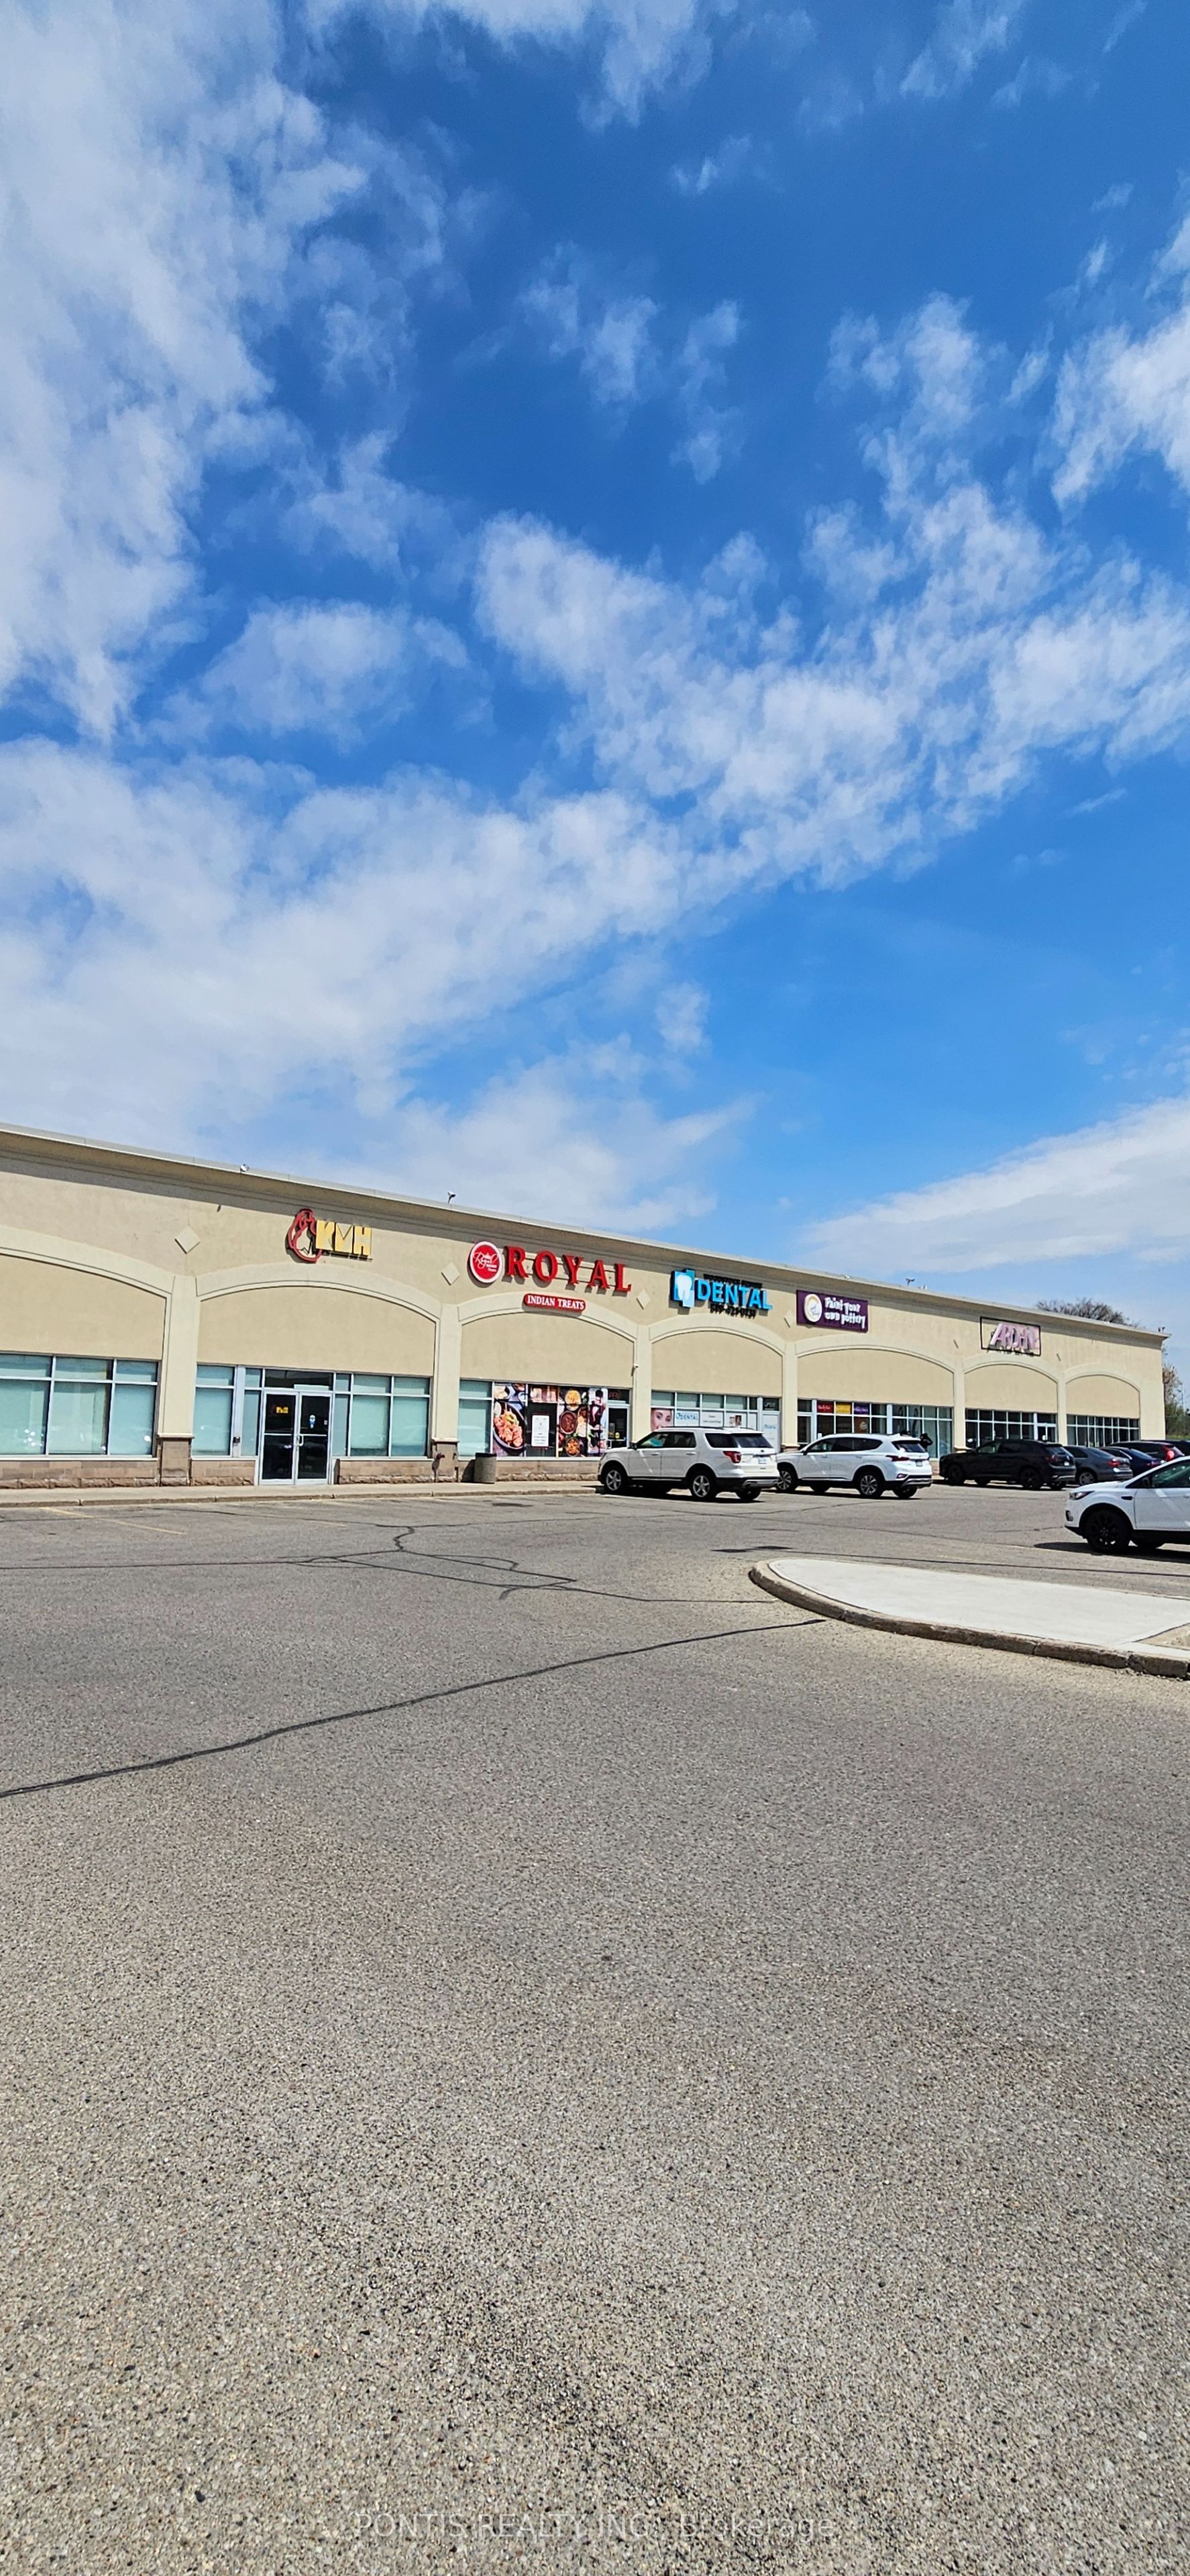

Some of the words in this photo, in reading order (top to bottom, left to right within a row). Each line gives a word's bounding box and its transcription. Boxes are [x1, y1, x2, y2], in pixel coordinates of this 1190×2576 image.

[504, 1246, 632, 1292] ROYAL
[527, 1295, 555, 1306] INDIAN
[557, 1298, 585, 1309] TREATS
[697, 1279, 773, 1310] DENTAL
[824, 1297, 843, 1311] Paint
[843, 1303, 861, 1315] your
[824, 1312, 840, 1320] own
[841, 1312, 866, 1329] pottery
